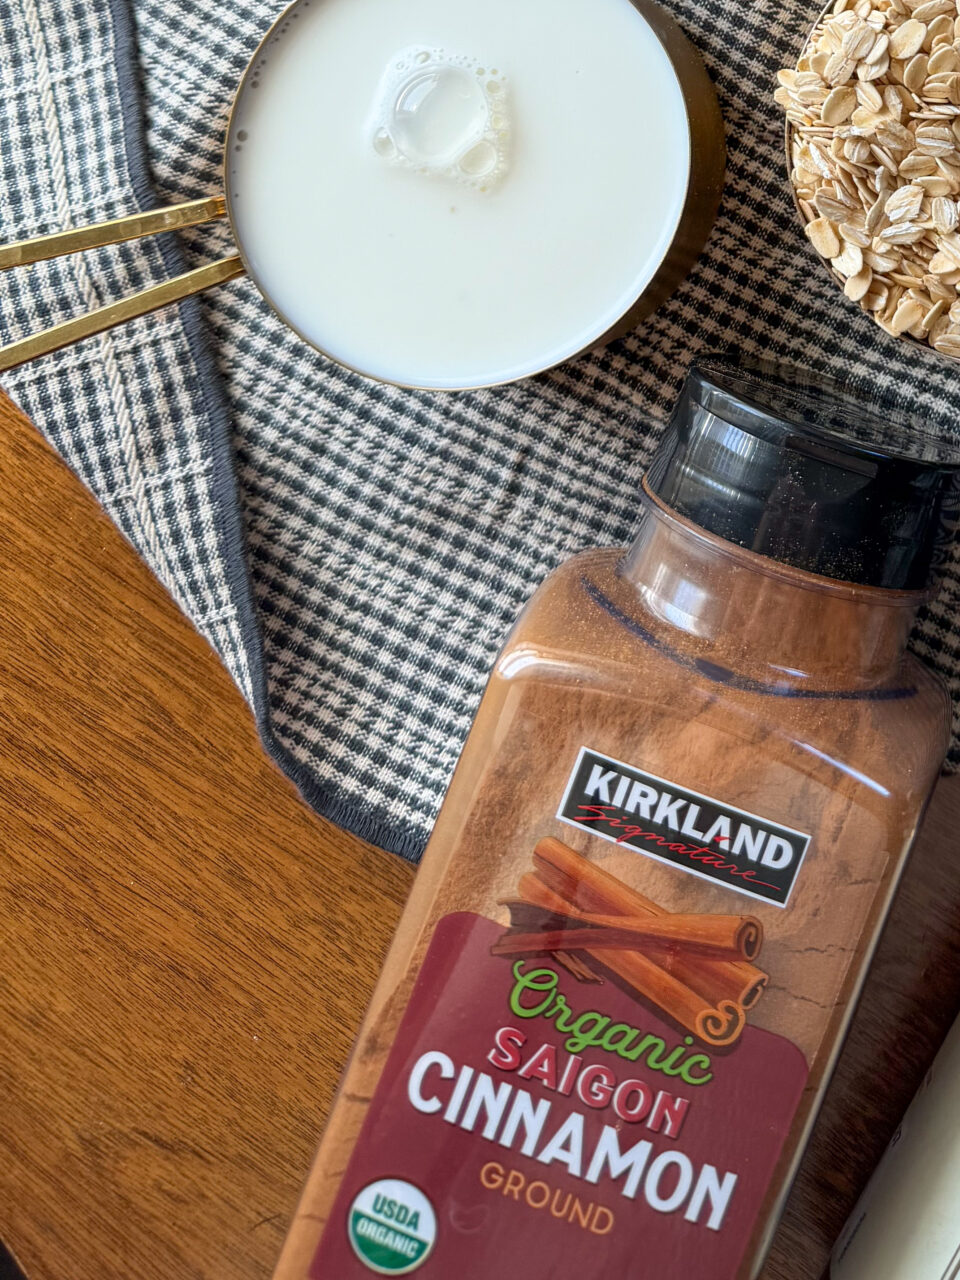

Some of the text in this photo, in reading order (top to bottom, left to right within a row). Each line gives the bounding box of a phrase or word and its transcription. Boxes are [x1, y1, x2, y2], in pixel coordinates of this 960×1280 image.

[574, 804, 781, 891] Signature
[584, 764, 793, 870] KIRKLAND
[509, 959, 714, 1086] Organic
[488, 1026, 690, 1138] SAIGON
[407, 1050, 738, 1231] CINNAMON
[357, 1217, 419, 1258] ORGANIC
[372, 1193, 421, 1231] USDA
[480, 1162, 614, 1235] GROUND
